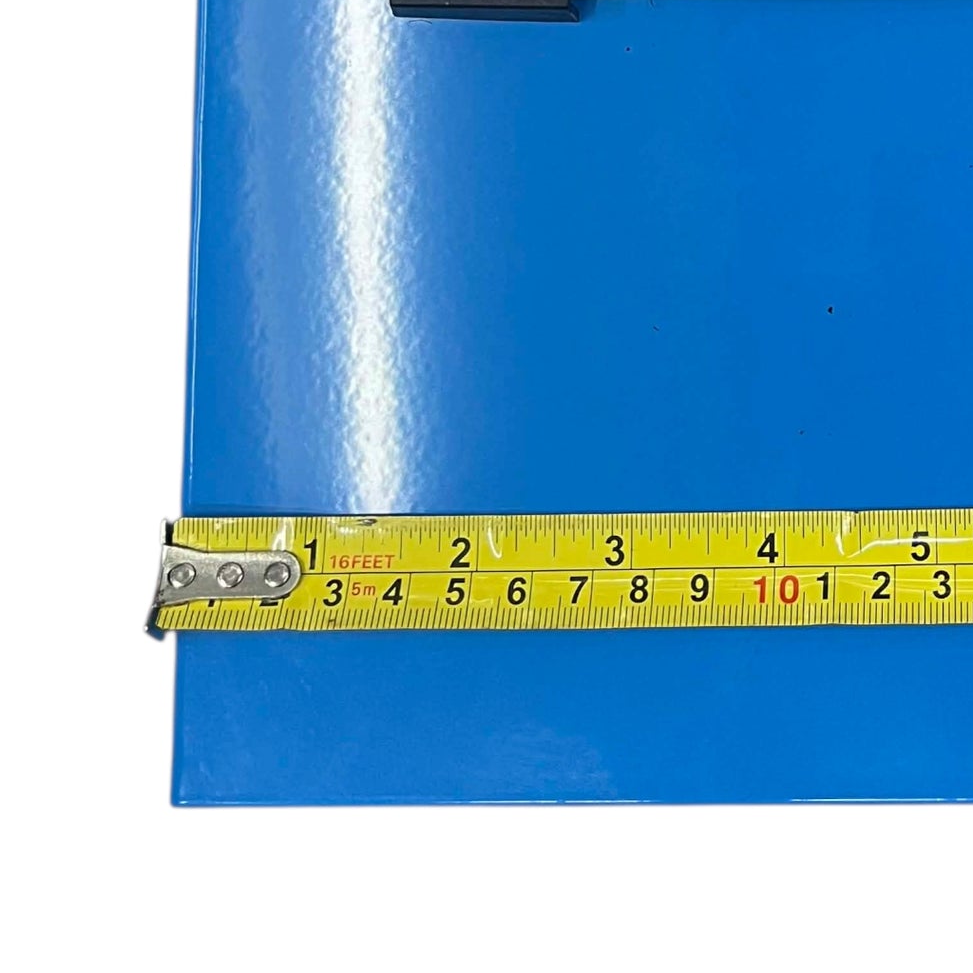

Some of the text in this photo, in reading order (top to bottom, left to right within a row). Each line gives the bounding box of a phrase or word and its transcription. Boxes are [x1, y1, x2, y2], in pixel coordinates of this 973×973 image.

[304, 538, 318, 570] 1
[450, 538, 470, 568] 2
[605, 536, 625, 566] 3
[757, 533, 779, 563] 4
[911, 531, 930, 562] 5
[323, 579, 342, 606] 3
[382, 578, 403, 605] 4
[445, 578, 465, 605] 5
[507, 577, 526, 605] 6
[569, 577, 589, 603] 7
[629, 575, 649, 603] 8
[690, 574, 709, 602] 9
[754, 576, 799, 604] 10
[817, 572, 830, 600] 1
[872, 571, 891, 599] 2
[932, 570, 952, 599] 3
[352, 583, 376, 596] 5m
